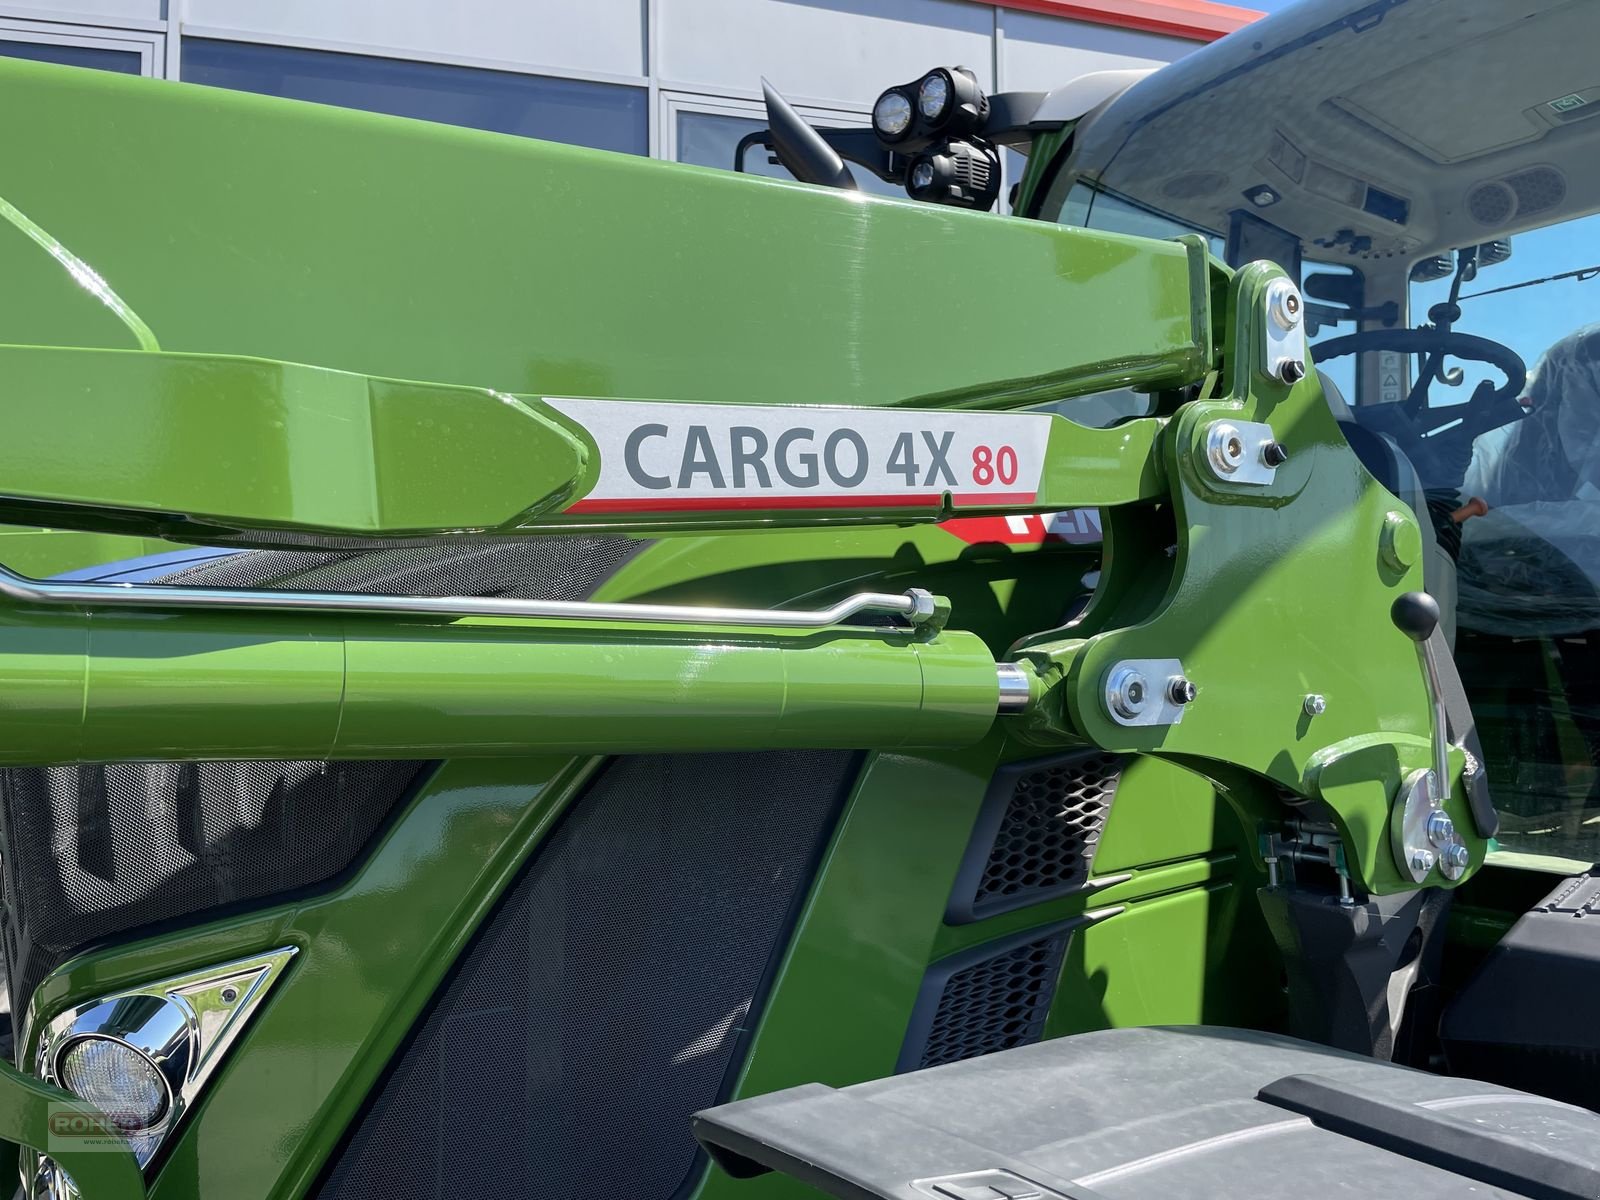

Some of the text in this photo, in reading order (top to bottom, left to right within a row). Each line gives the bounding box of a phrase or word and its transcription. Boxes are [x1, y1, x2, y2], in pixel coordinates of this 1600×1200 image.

[624, 423, 1018, 489] CARGO 4X 80
